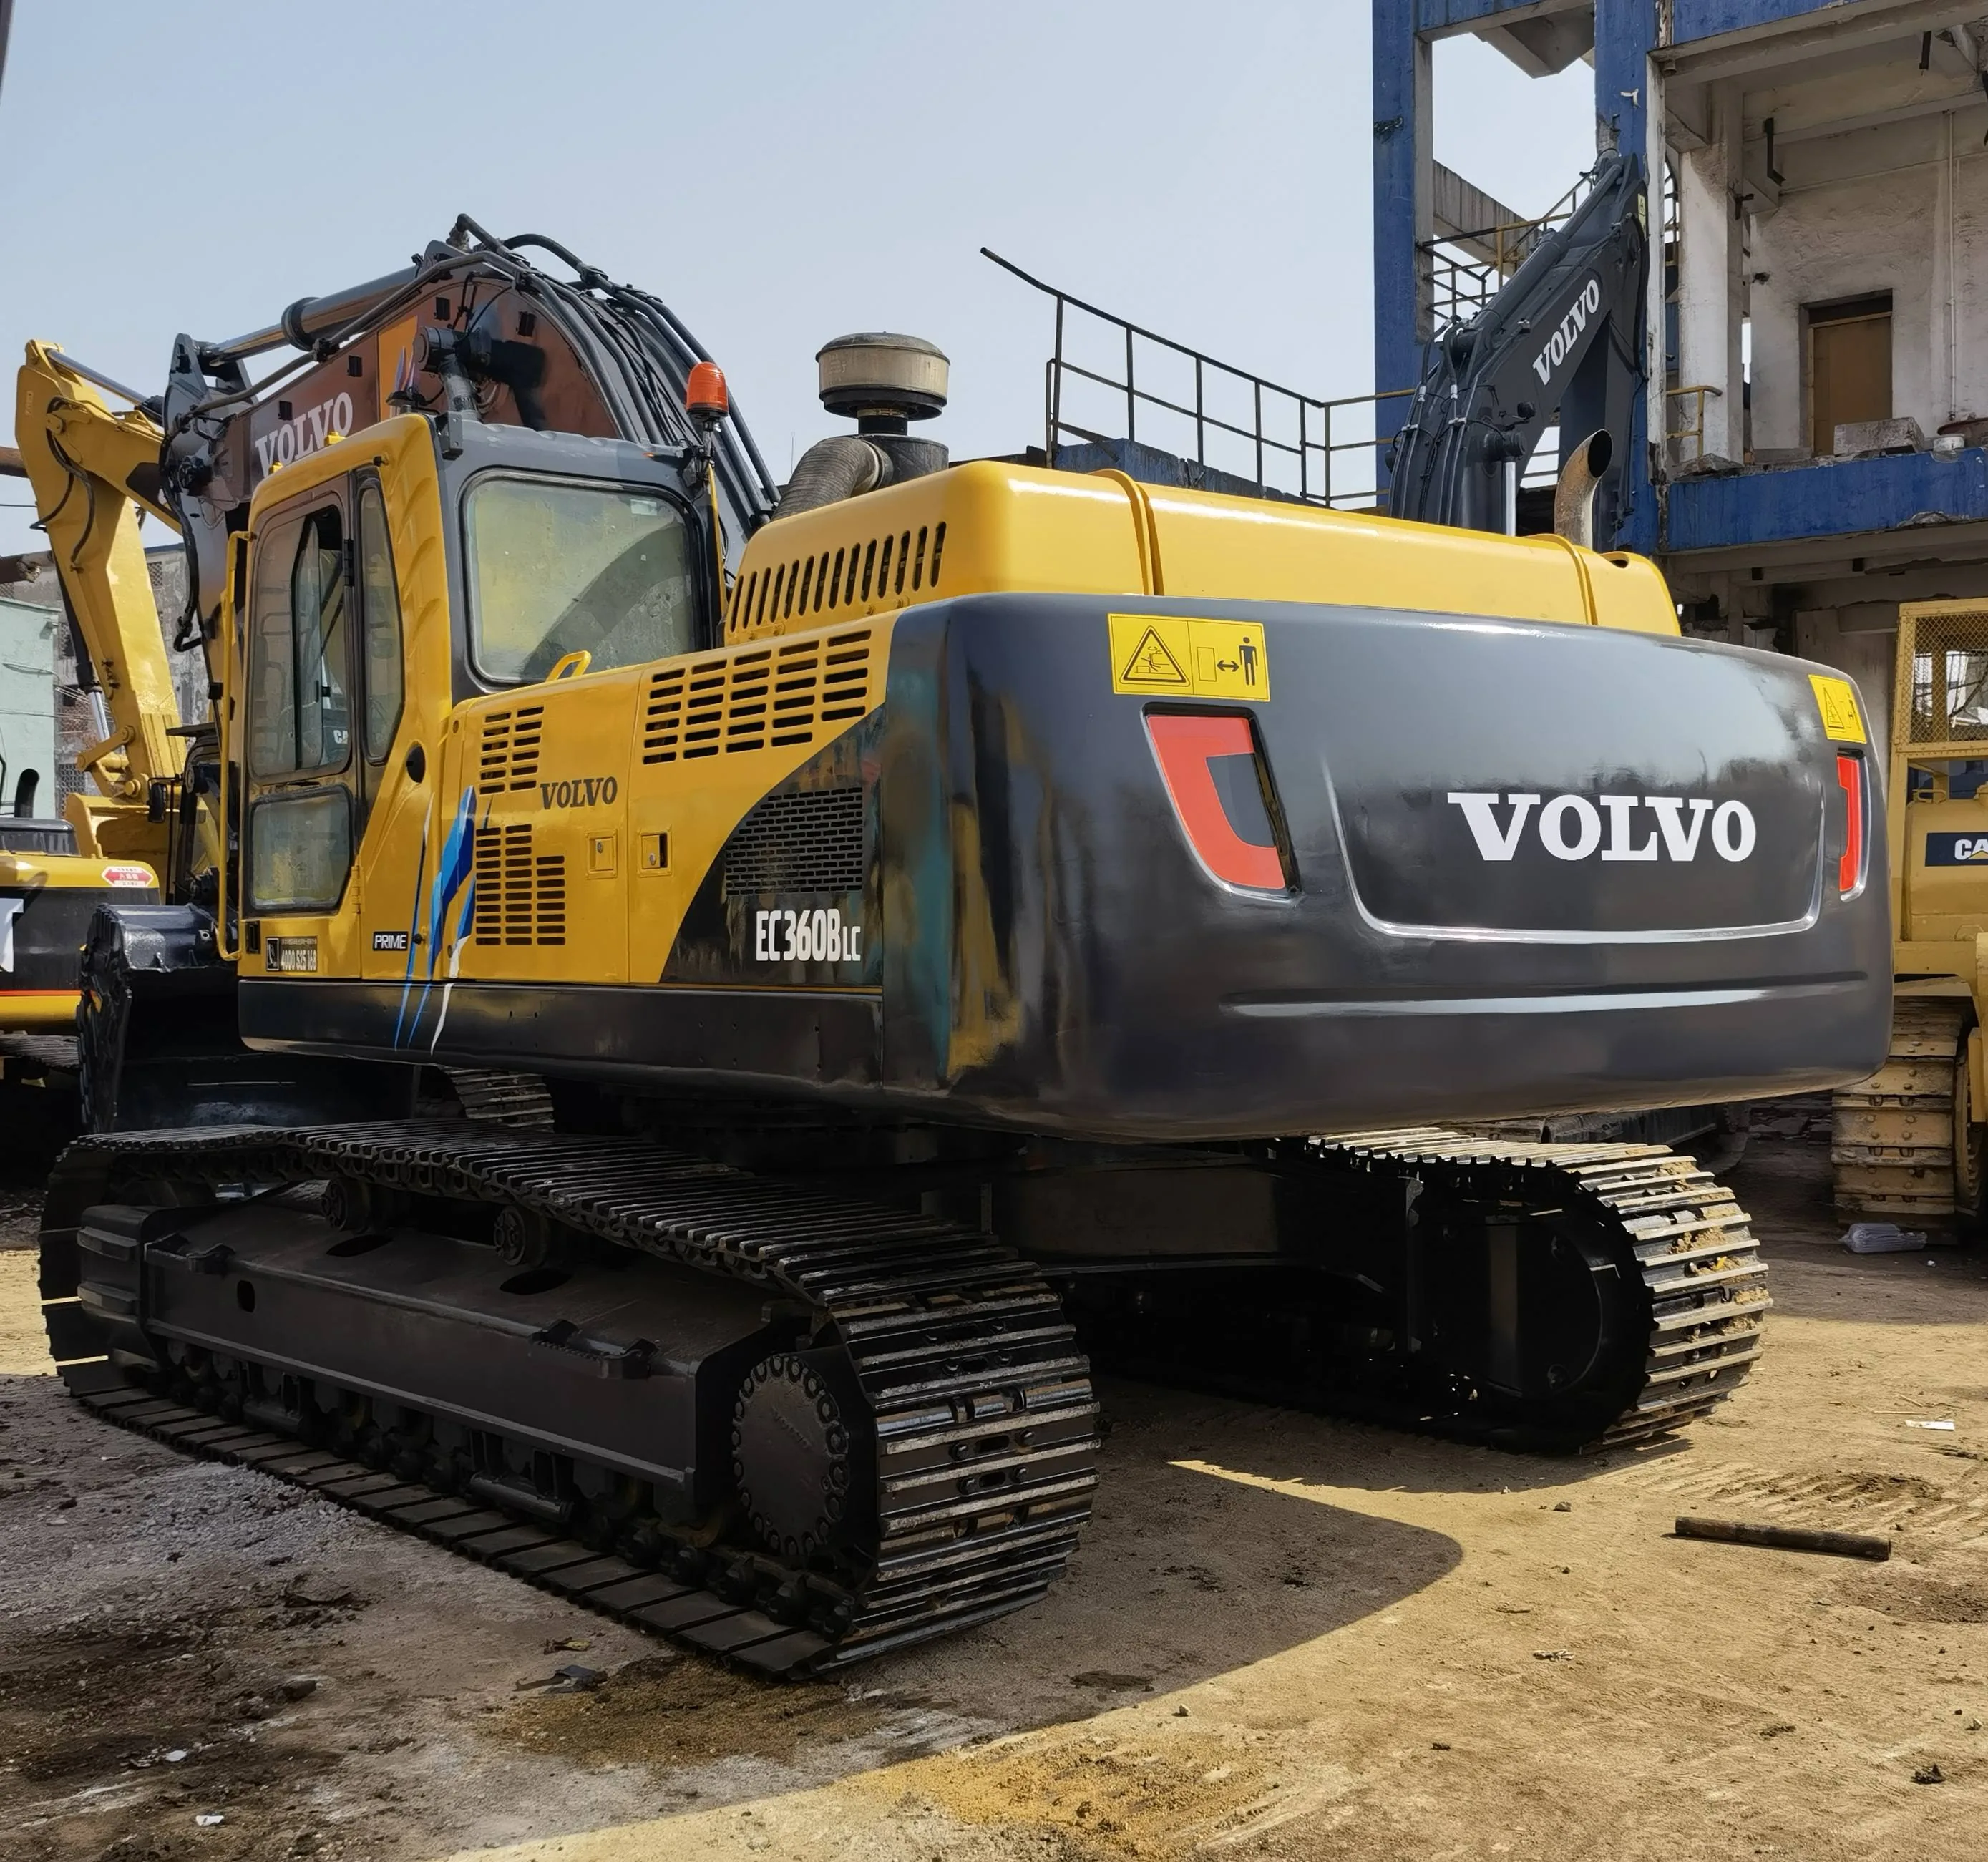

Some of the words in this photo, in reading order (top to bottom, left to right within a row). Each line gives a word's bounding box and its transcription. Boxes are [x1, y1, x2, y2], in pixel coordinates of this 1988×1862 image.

[1532, 279, 1599, 386] VOLVO
[255, 392, 353, 479] VOLVO
[540, 776, 618, 810] VOLVO
[1448, 792, 1756, 862] VOLVO
[374, 935, 406, 949] PRIME
